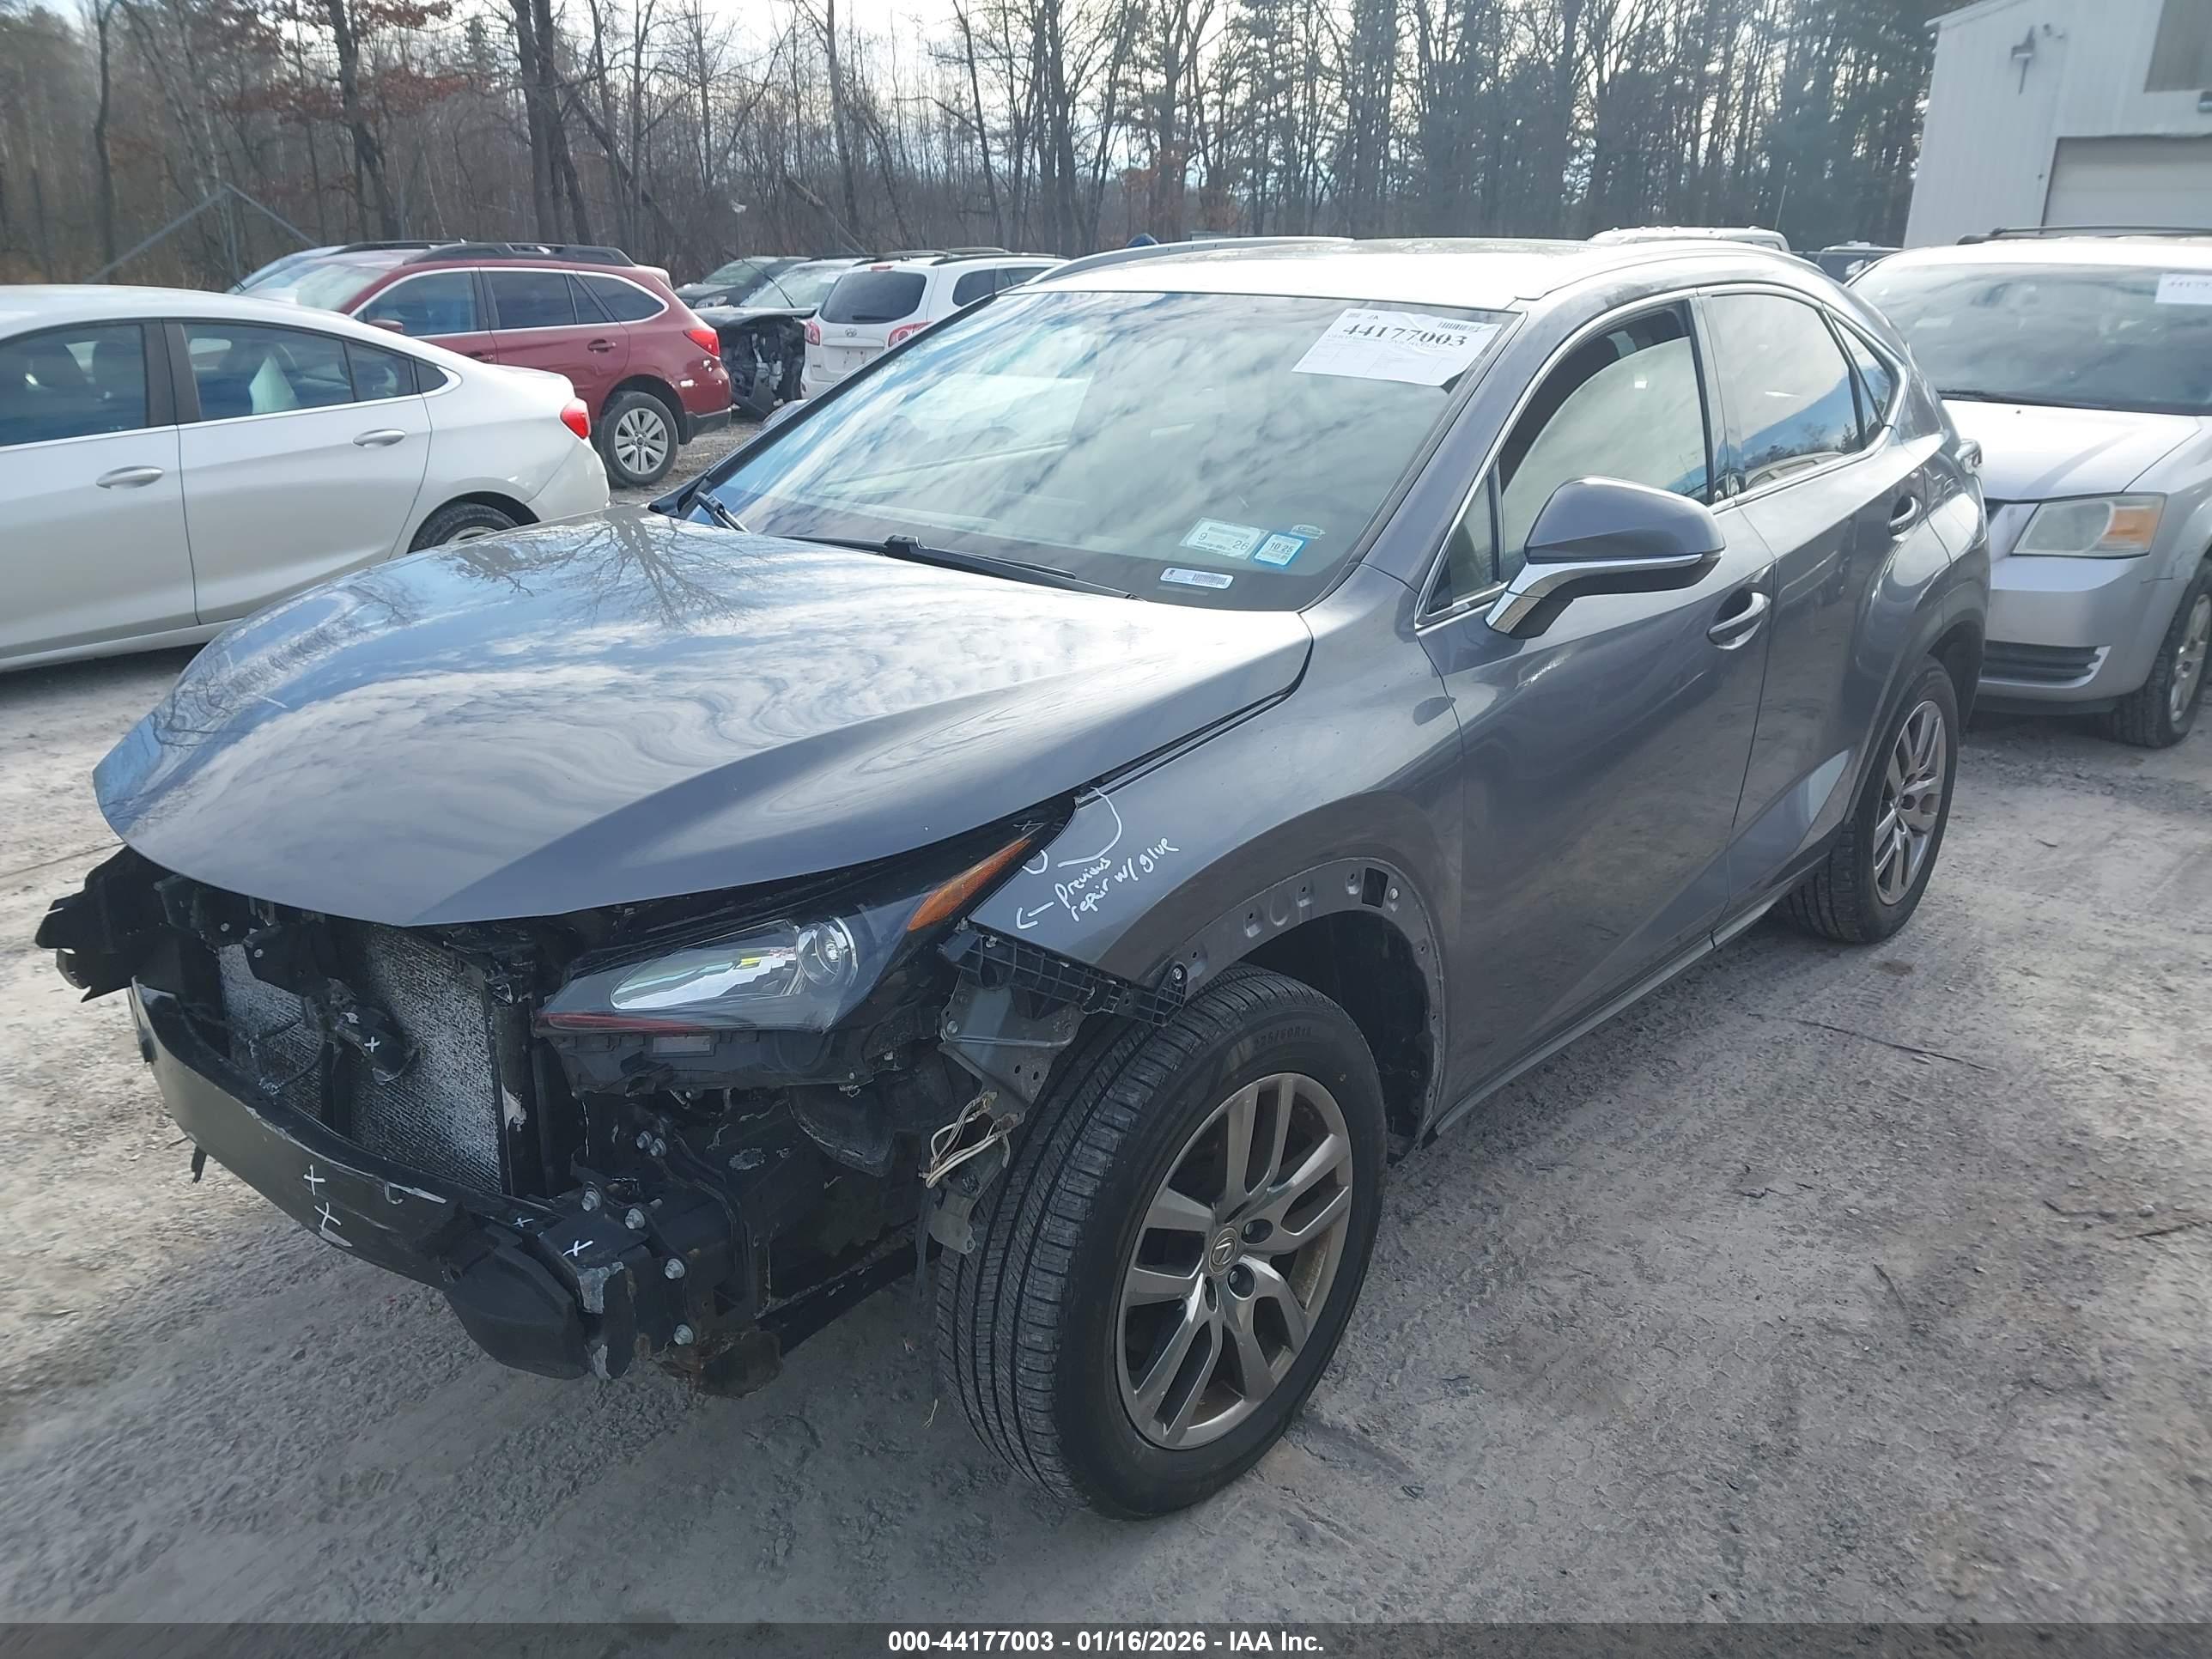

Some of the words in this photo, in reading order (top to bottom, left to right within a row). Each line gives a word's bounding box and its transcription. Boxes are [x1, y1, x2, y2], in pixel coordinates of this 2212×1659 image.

[1342, 323, 1468, 348] 44177003
[1070, 878, 1109, 922] repair
[1114, 857, 1139, 882] w/
[1139, 837, 1180, 874] glue
